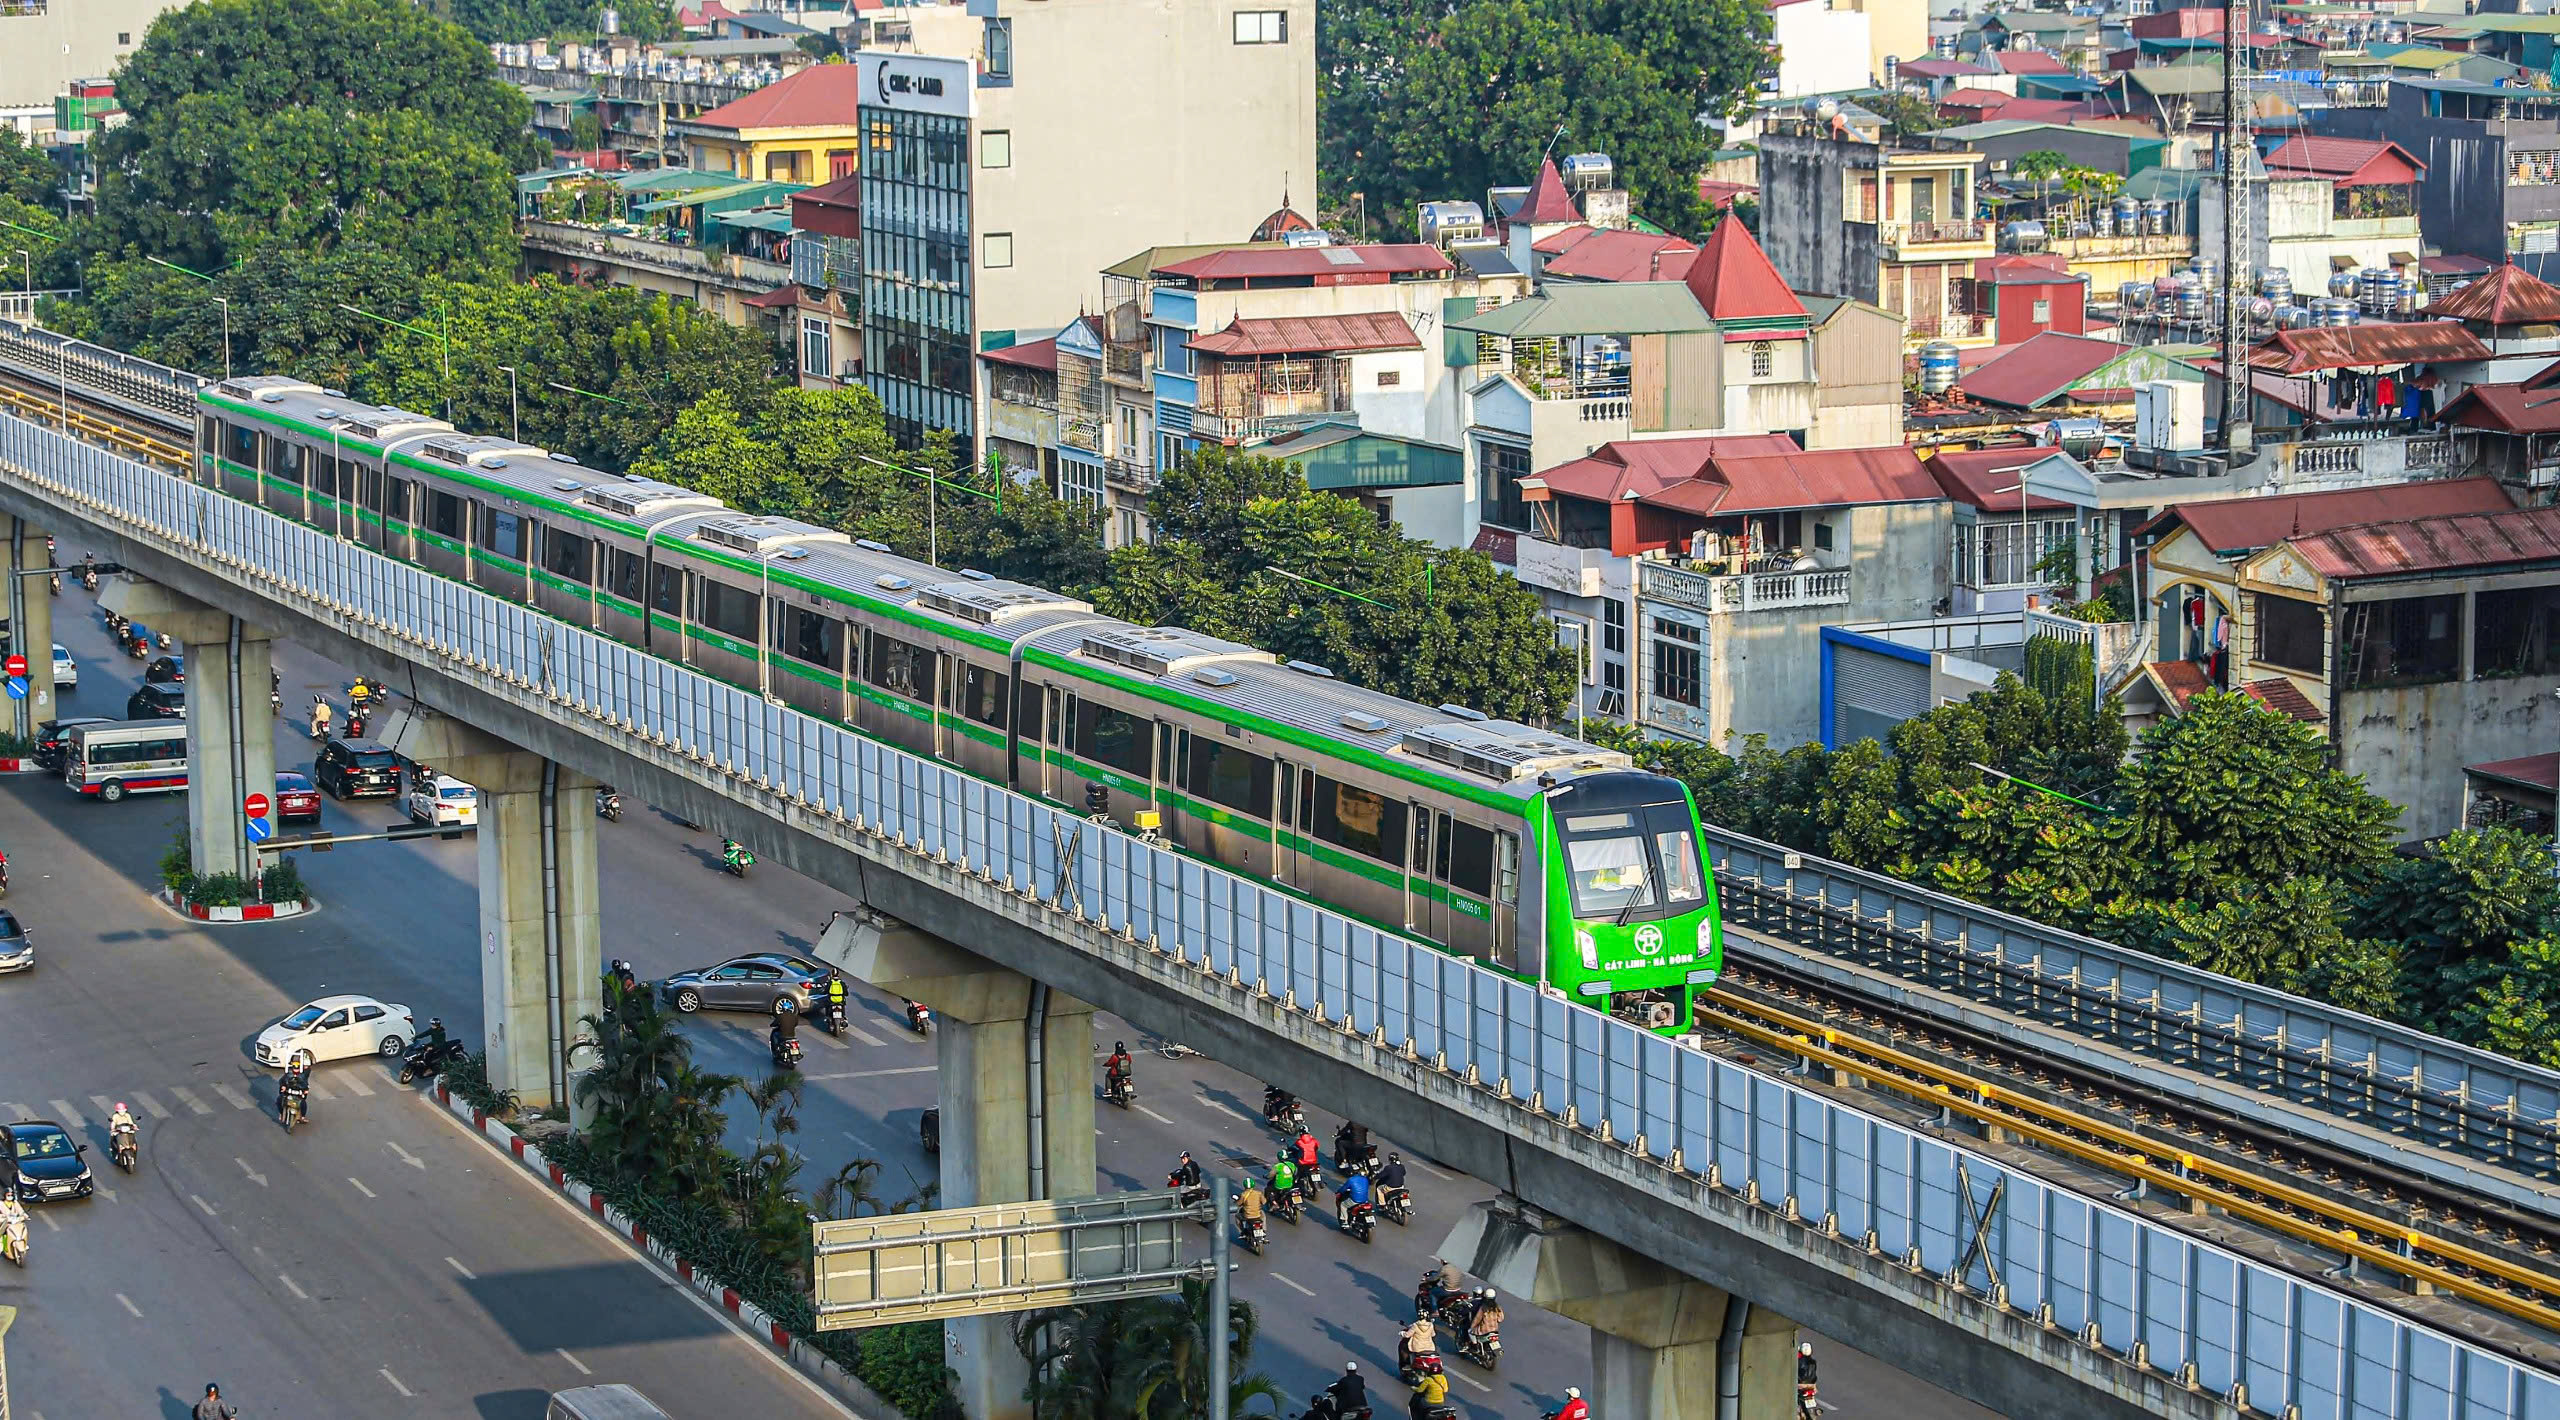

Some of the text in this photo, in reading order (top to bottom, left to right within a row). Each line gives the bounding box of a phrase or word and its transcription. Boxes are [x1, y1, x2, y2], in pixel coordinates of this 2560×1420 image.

[1786, 856, 1799, 866] 040
[1456, 897, 1474, 913] HN005
[1604, 959, 1623, 972] CÁT
[1625, 959, 1647, 969] LINH
[1652, 955, 1666, 967] HÀ
[1668, 953, 1695, 965] ĐÔNG
